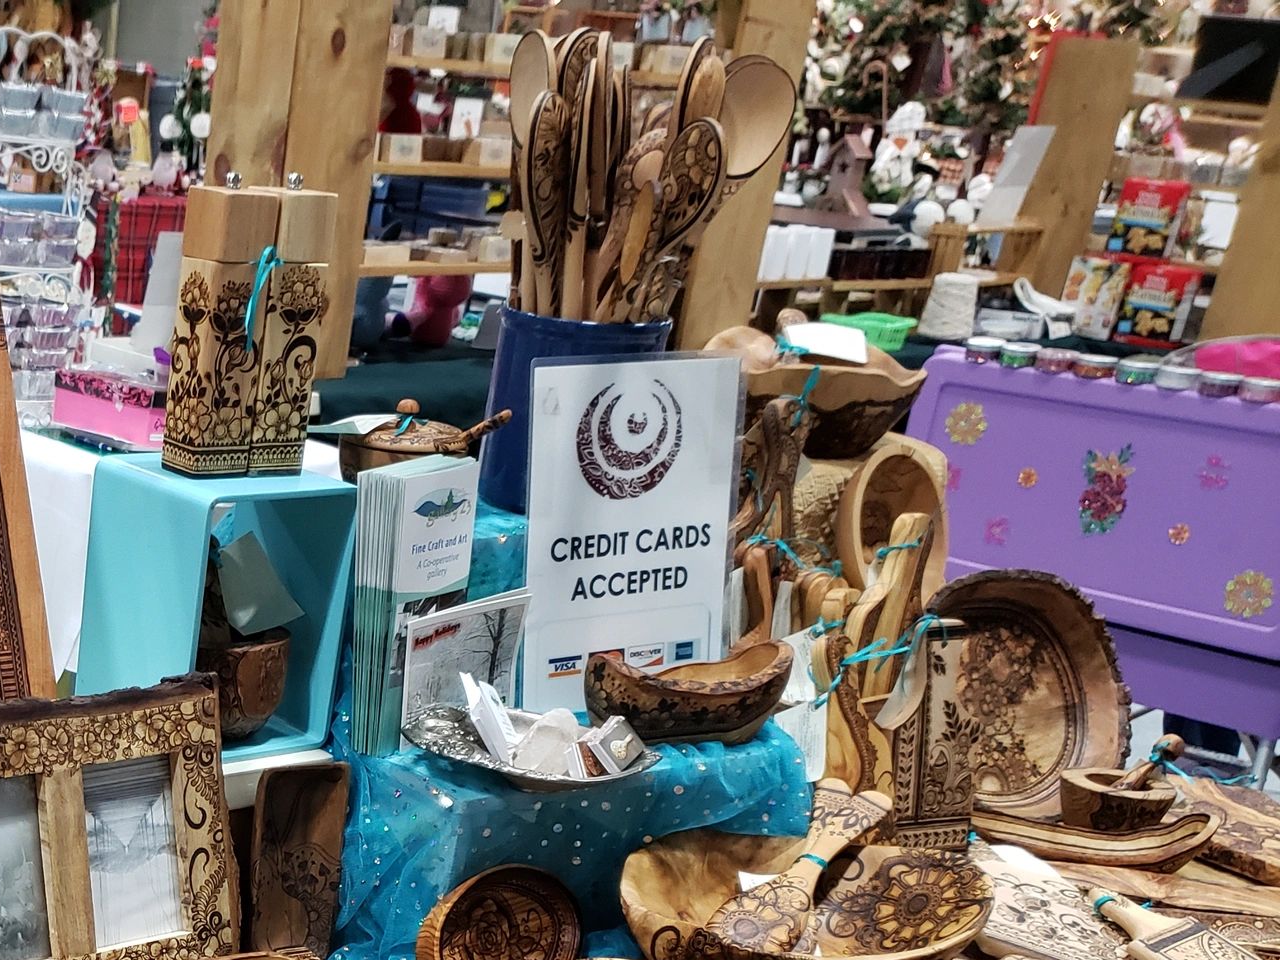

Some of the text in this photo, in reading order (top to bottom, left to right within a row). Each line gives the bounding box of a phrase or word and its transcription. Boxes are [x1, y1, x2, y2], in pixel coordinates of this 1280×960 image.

[411, 534, 468, 555] Fine Craft and Art
[550, 523, 711, 562] CREDIT CARDS
[426, 568, 447, 581] gallery
[571, 566, 688, 601] ACCEPTED
[629, 649, 662, 658] DISCOVER
[554, 661, 577, 672] VISA
